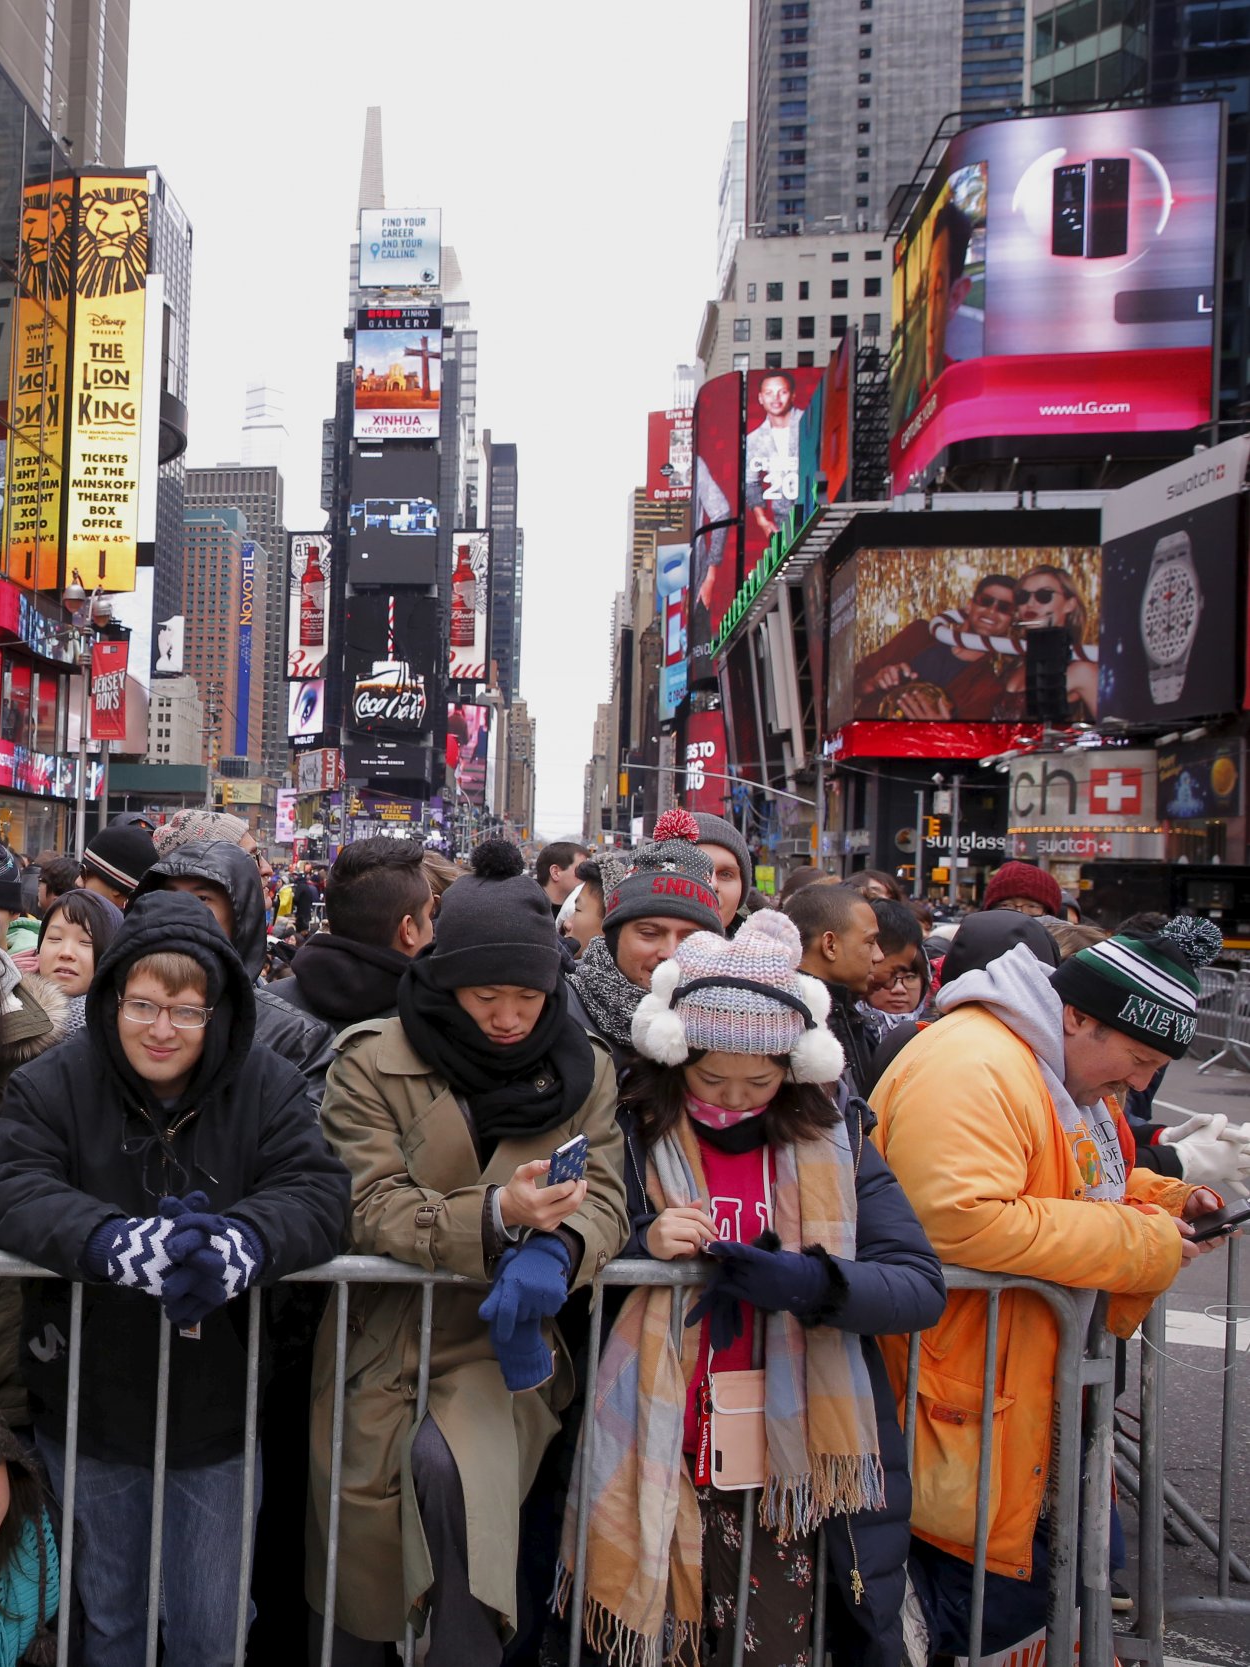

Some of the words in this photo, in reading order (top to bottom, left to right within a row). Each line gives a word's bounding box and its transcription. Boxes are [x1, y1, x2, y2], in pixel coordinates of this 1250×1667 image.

[381, 218, 401, 228] FIND
[404, 217, 426, 227] YOUR
[381, 228, 414, 238] CAREER
[381, 239, 399, 248] AND
[401, 239, 423, 248] YOUR
[381, 249, 418, 260] CALLING.
[401, 310, 430, 318] XINHUA
[368, 319, 430, 329] GALLERY
[89, 342, 123, 359] THE
[83, 362, 130, 390] LION
[78, 392, 136, 426] KING
[1038, 402, 1131, 416] www.LG.com
[372, 416, 422, 426] XINHUA
[392, 427, 433, 435] AGENCY
[81, 453, 128, 463] TICKETS
[83, 467, 98, 476] AT
[103, 467, 125, 477] THE
[71, 479, 136, 490] MINSKOFF
[77, 492, 129, 503] THEATRE
[90, 506, 116, 515] BOX
[81, 518, 123, 529] OFFICE
[103, 534, 110, 543] &
[239, 550, 255, 626] NOVOTEL
[91, 671, 126, 694] JERSEY
[96, 691, 120, 711] BOYS
[698, 741, 716, 758] TO
[1036, 837, 1098, 854] swatch
[1117, 994, 1197, 1045] NEW
[698, 1421, 710, 1478] Lufthansa
